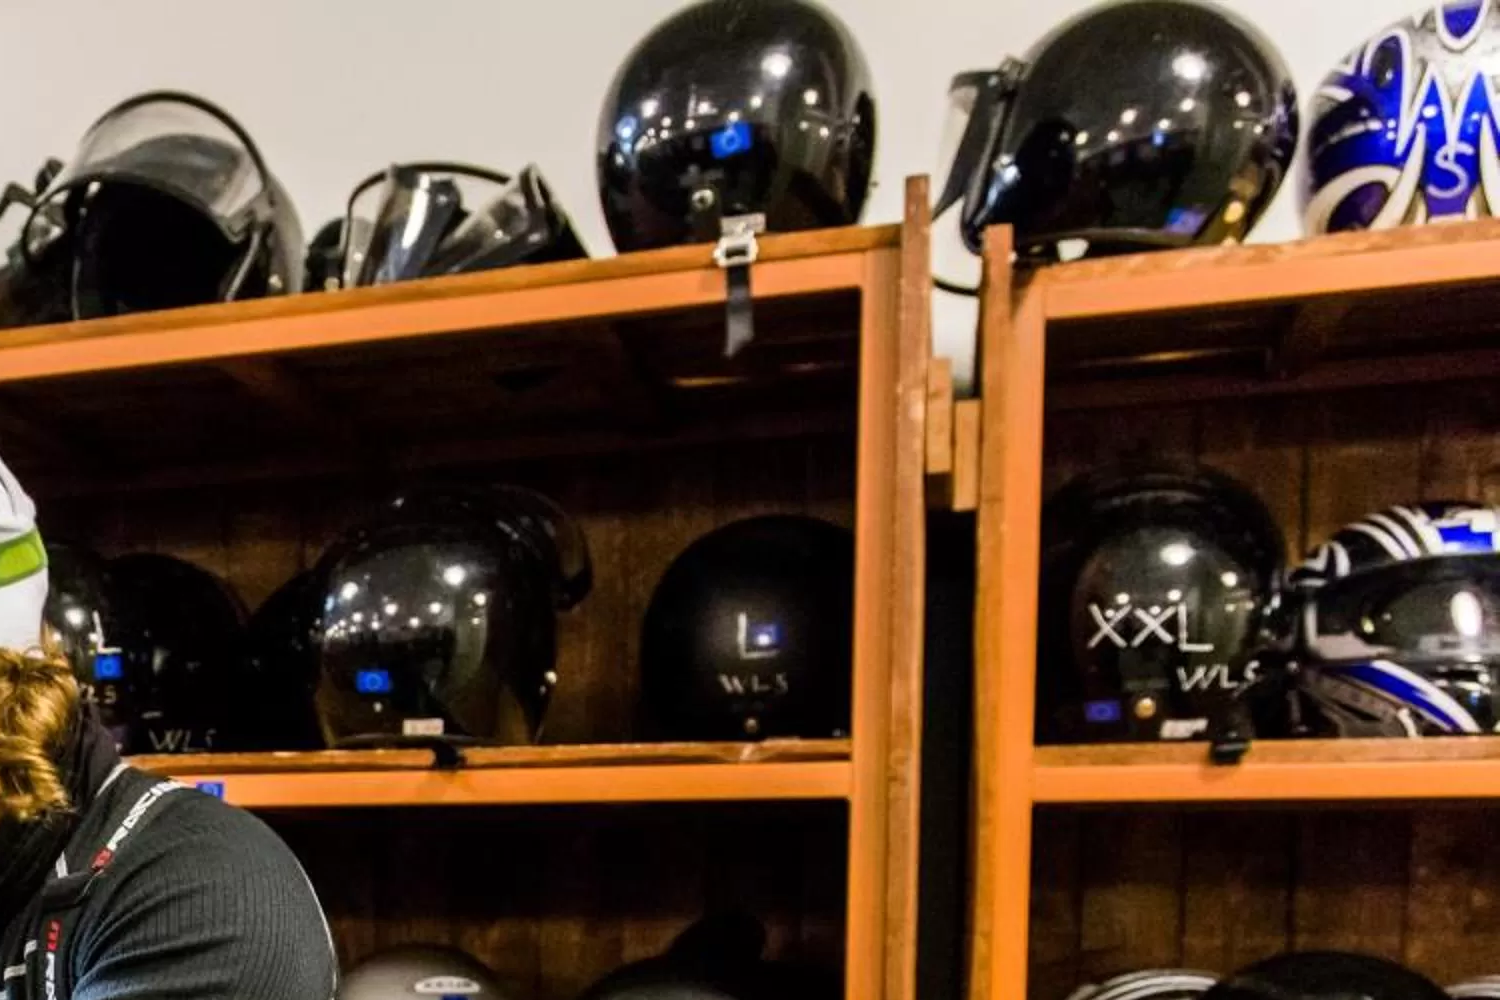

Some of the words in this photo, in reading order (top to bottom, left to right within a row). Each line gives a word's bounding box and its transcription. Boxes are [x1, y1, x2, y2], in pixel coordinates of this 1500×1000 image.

[1086, 602, 1214, 653] XXL
[717, 672, 789, 696] WLS
[1176, 660, 1261, 699] WLS
